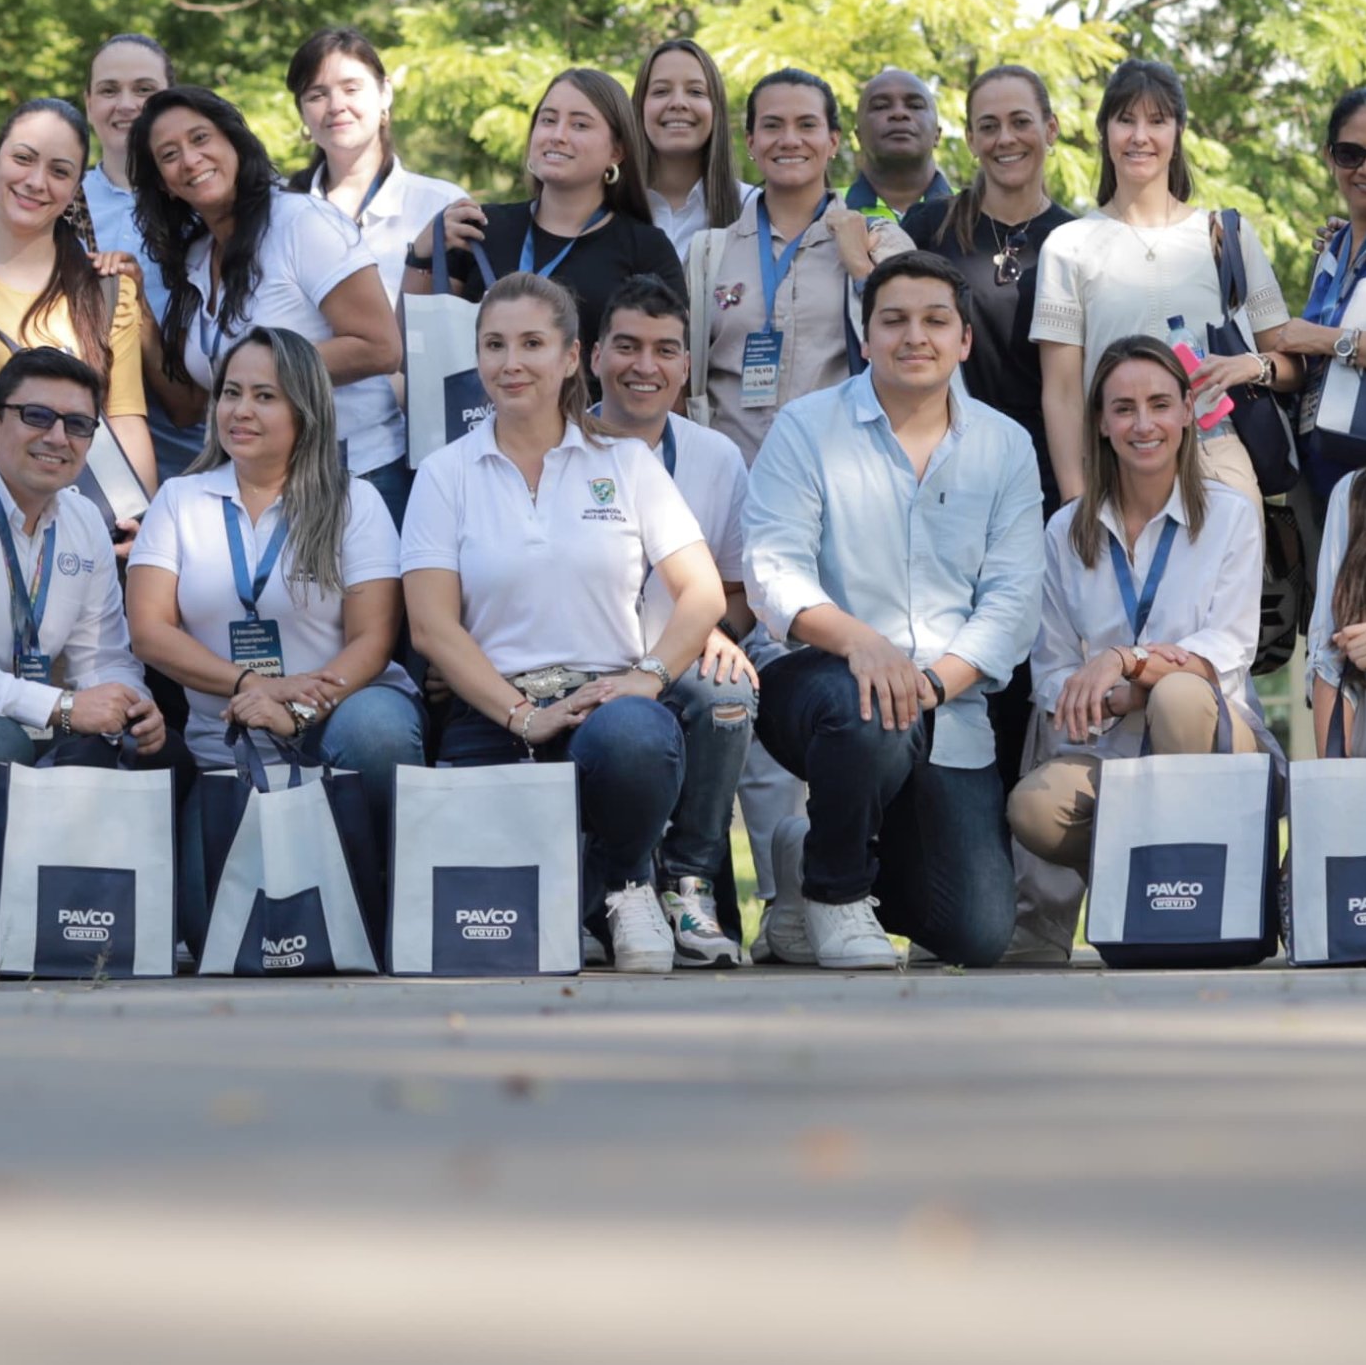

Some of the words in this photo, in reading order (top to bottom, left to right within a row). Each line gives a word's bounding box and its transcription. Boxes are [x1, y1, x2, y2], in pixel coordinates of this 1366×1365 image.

[1146, 881, 1204, 897] PAVCO
[1153, 899, 1194, 908] wavin
[58, 909, 115, 926] PAVCO
[456, 907, 518, 924] PAVCO
[66, 928, 106, 940] wavin
[466, 927, 508, 938] wavin
